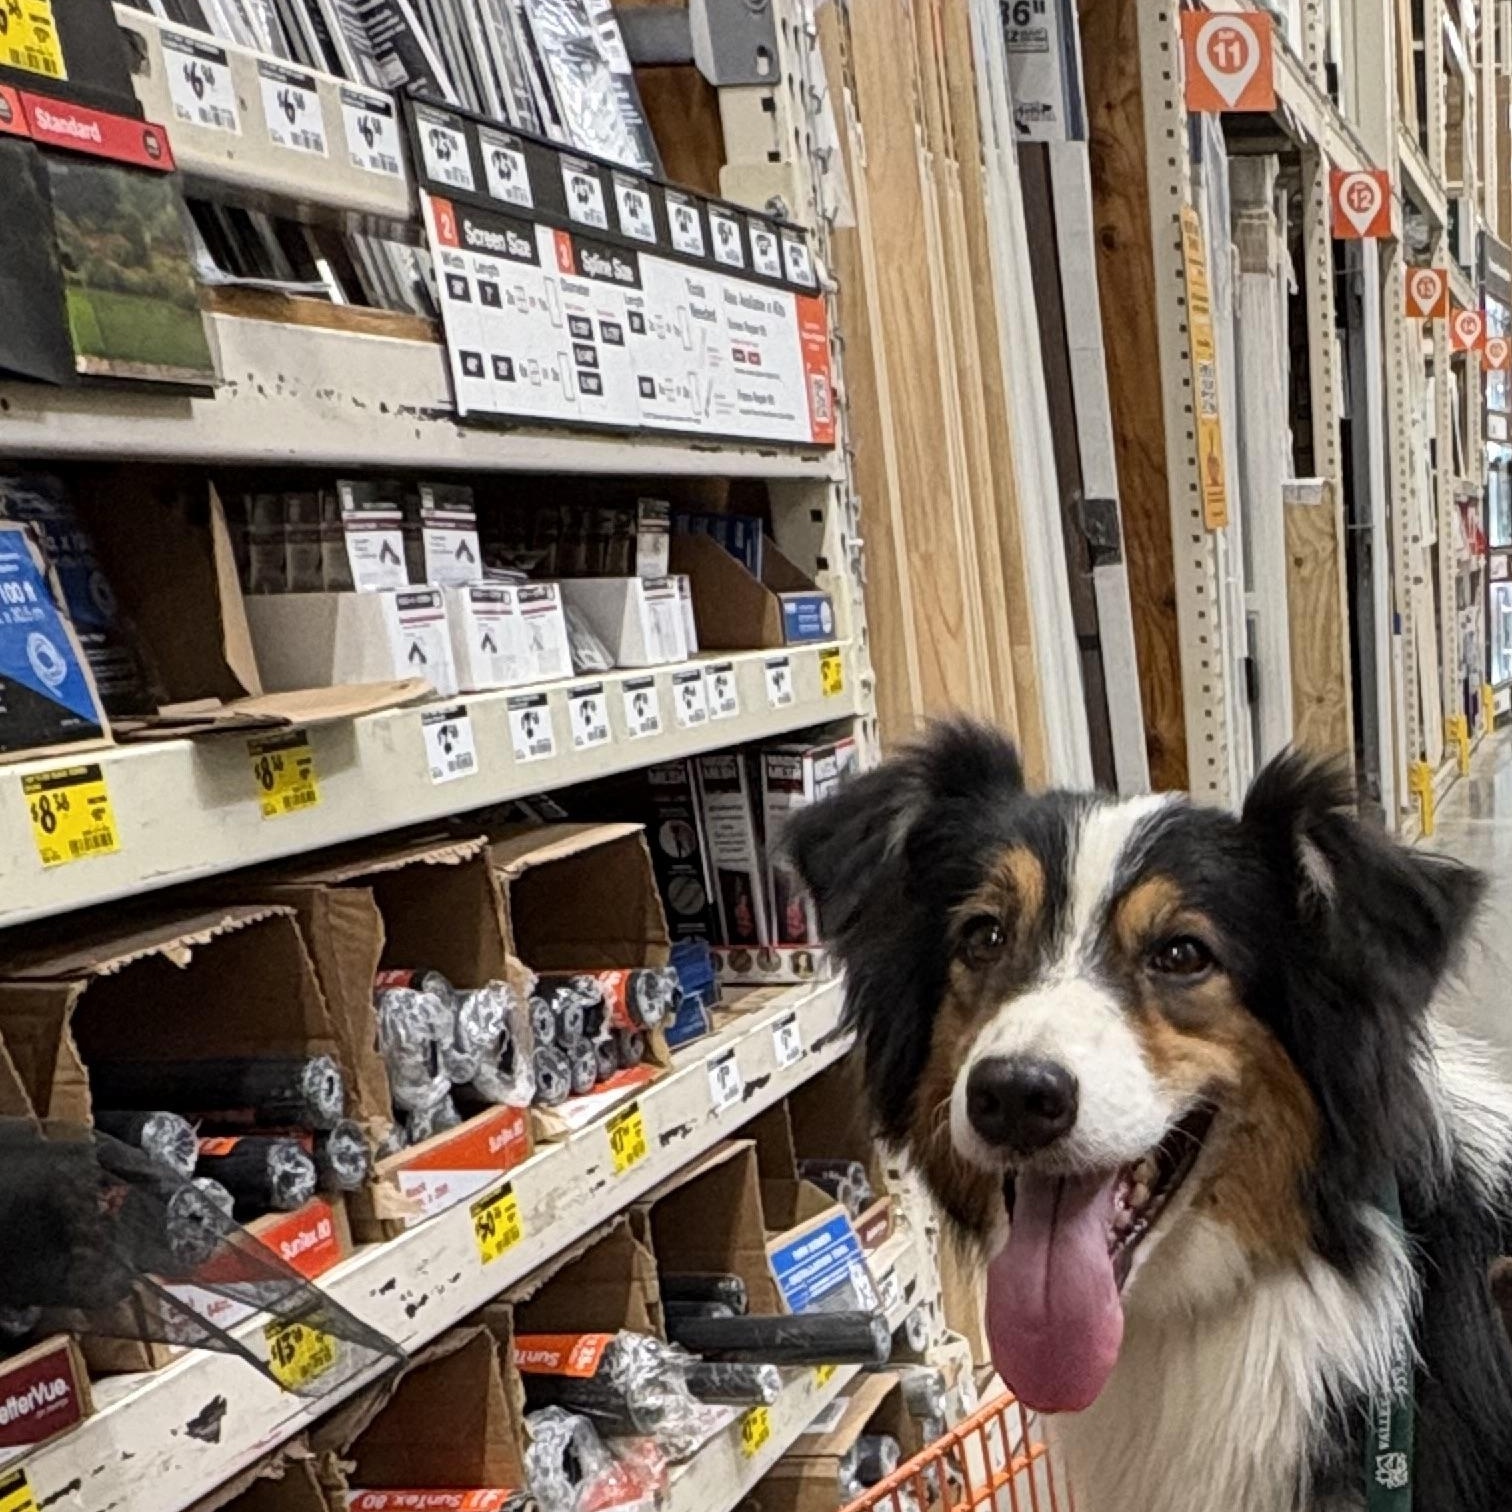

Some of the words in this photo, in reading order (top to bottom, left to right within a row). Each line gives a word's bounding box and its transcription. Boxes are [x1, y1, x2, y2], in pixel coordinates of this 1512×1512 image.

[1212, 41, 1241, 68] 11
[34, 106, 103, 144] Standard
[1349, 189, 1371, 210] 12
[440, 212, 452, 241] 2
[462, 218, 507, 254] Screen
[506, 230, 533, 259] Size
[393, 1493, 464, 1509] SunTex
